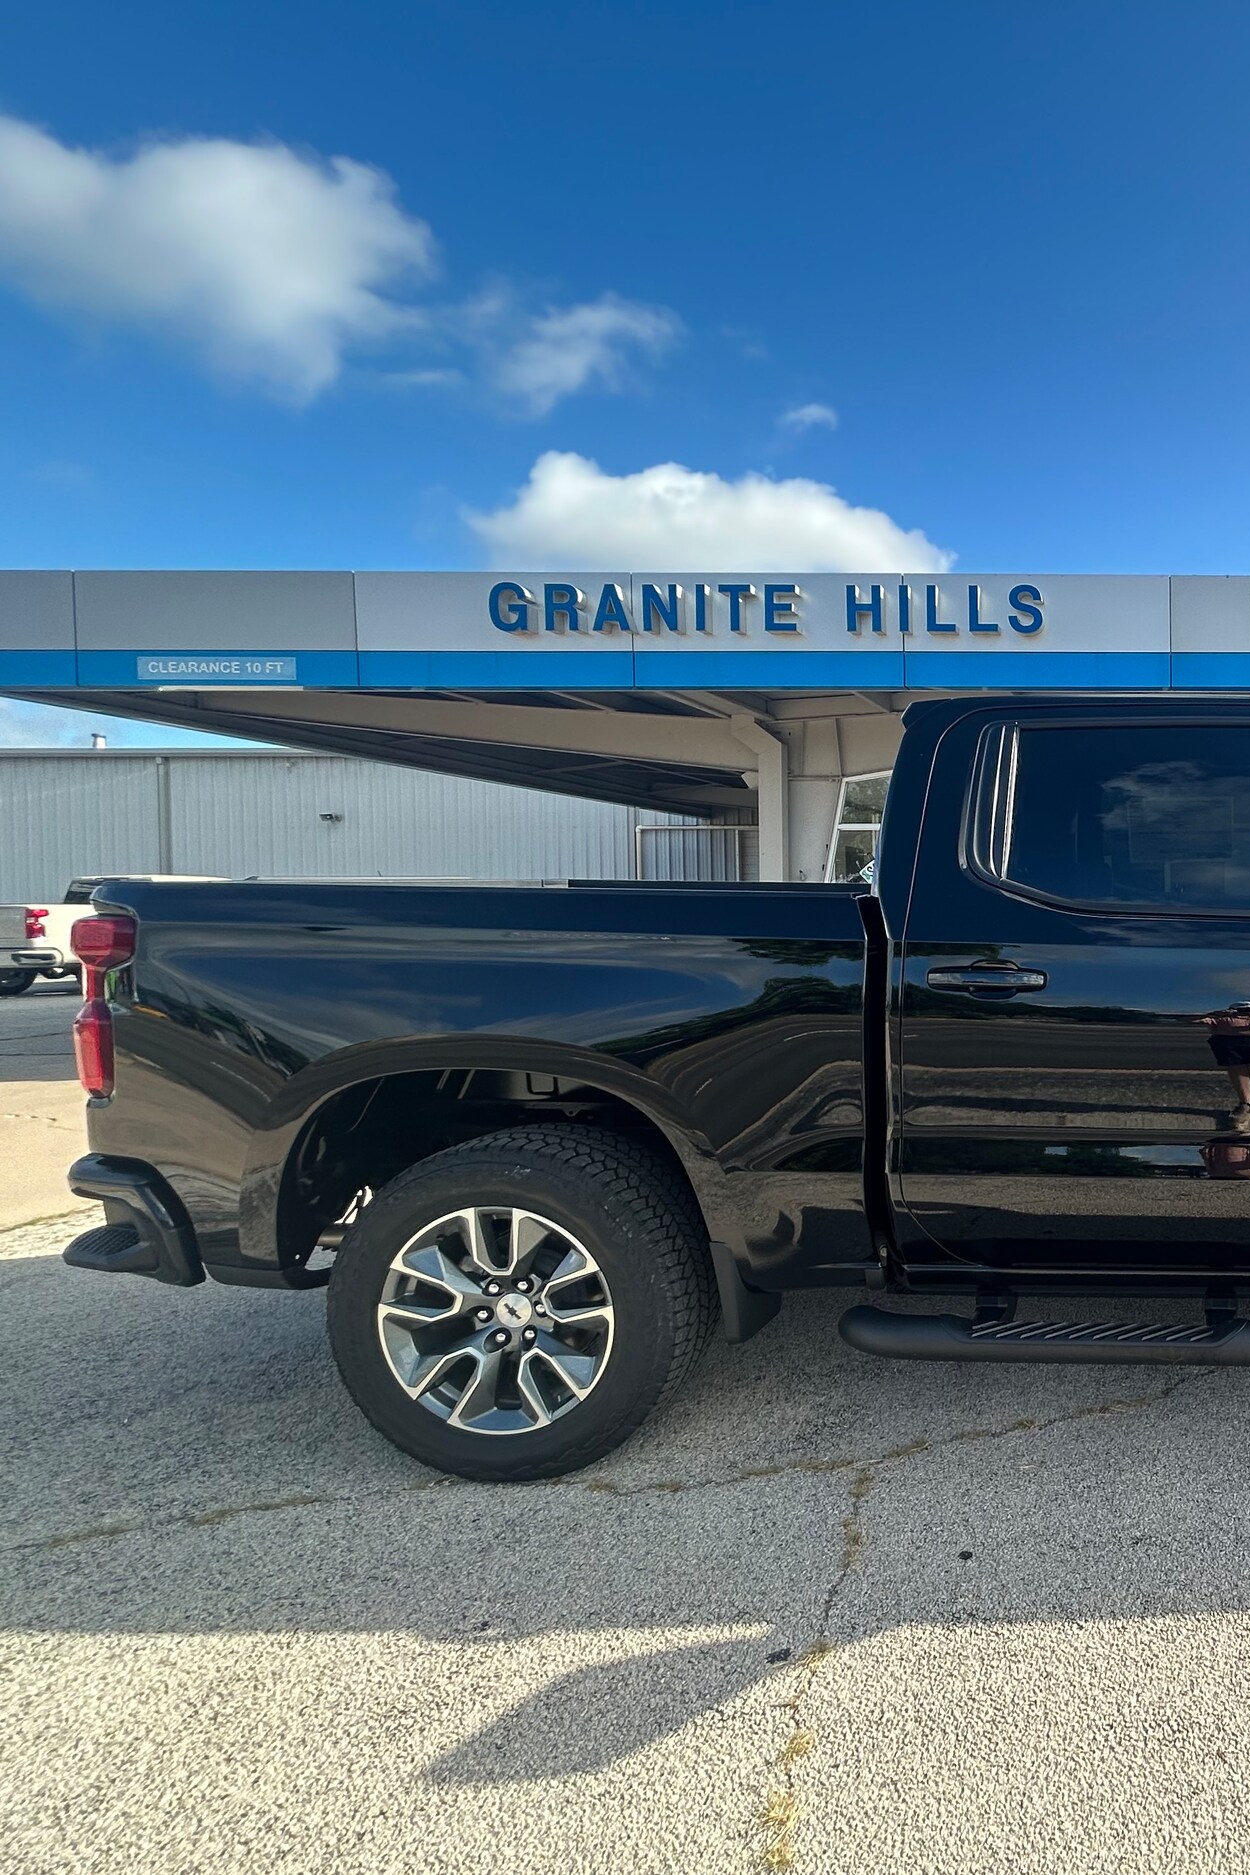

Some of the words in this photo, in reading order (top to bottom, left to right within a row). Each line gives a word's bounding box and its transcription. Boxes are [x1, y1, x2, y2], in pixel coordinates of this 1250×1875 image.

[488, 581, 799, 635] GRANITE
[846, 584, 1045, 636] HILLS
[148, 661, 241, 674] CLEARANCE
[245, 661, 262, 674] 10
[265, 661, 284, 674] FT
